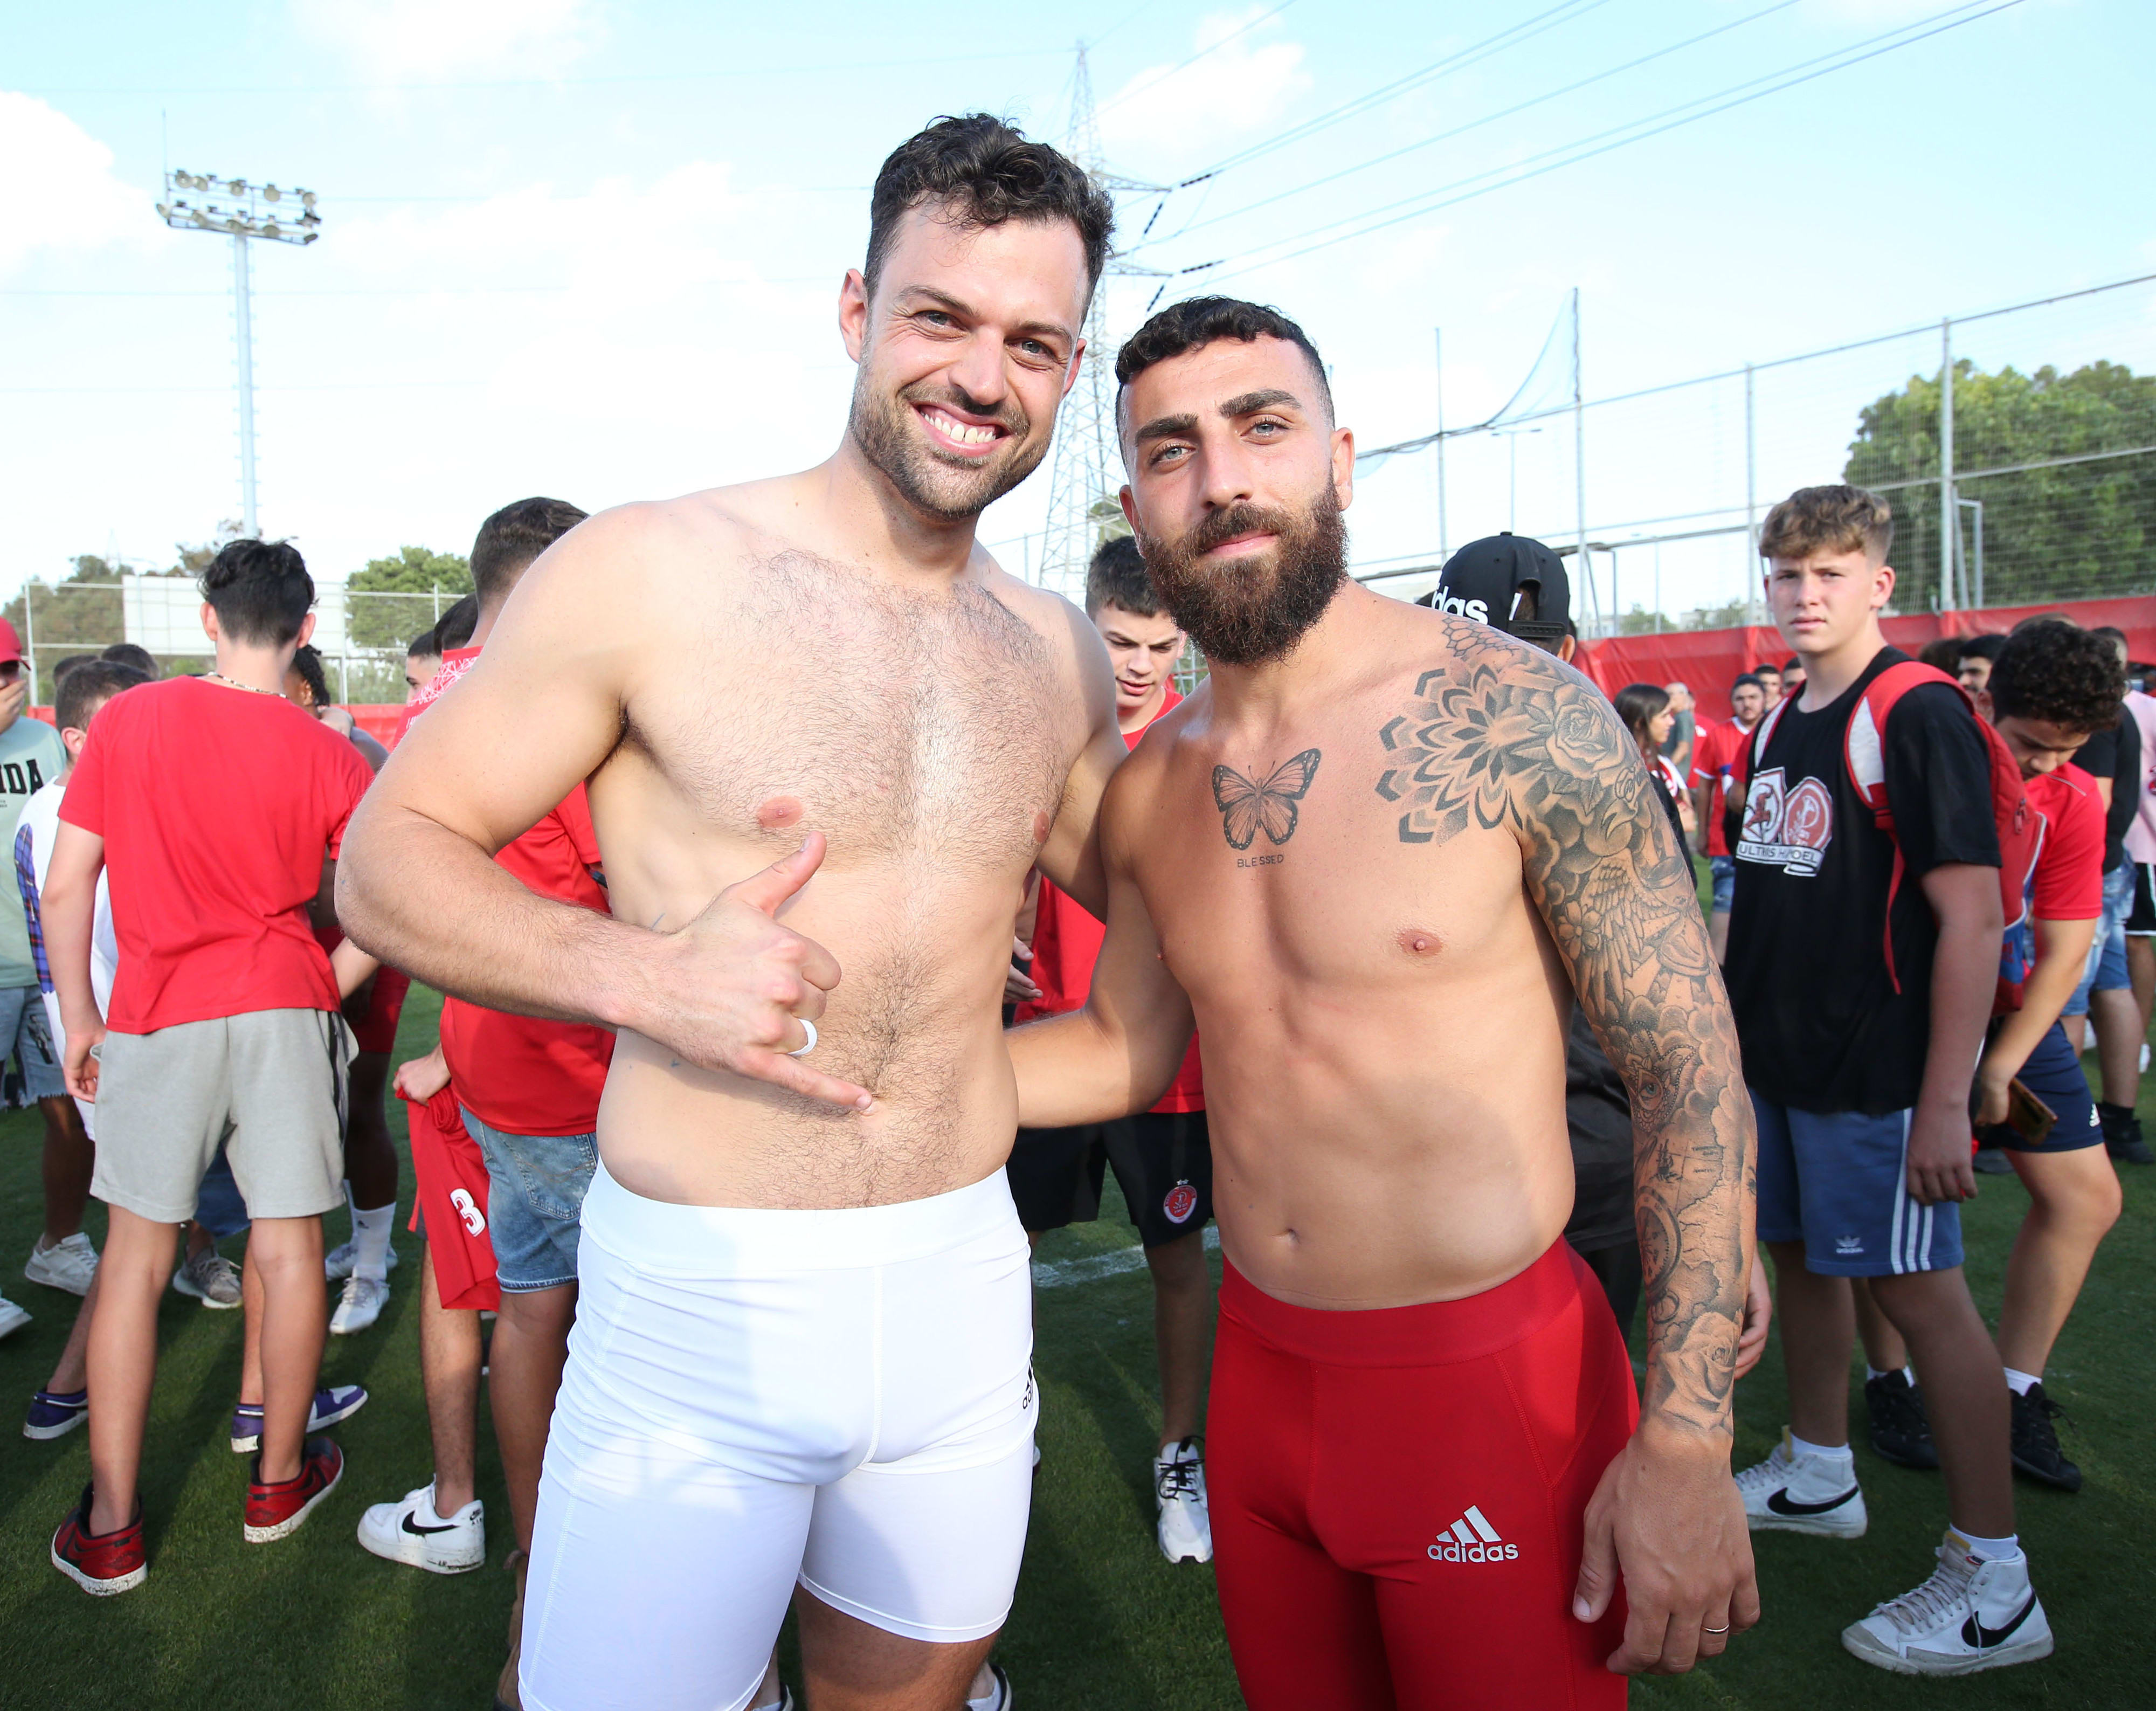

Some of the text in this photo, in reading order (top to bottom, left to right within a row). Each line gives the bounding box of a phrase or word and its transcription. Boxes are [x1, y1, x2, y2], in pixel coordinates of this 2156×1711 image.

[1237, 854, 1284, 867] BLESSED
[450, 1188, 486, 1238] 3
[1427, 1541, 1520, 1563] adidas
